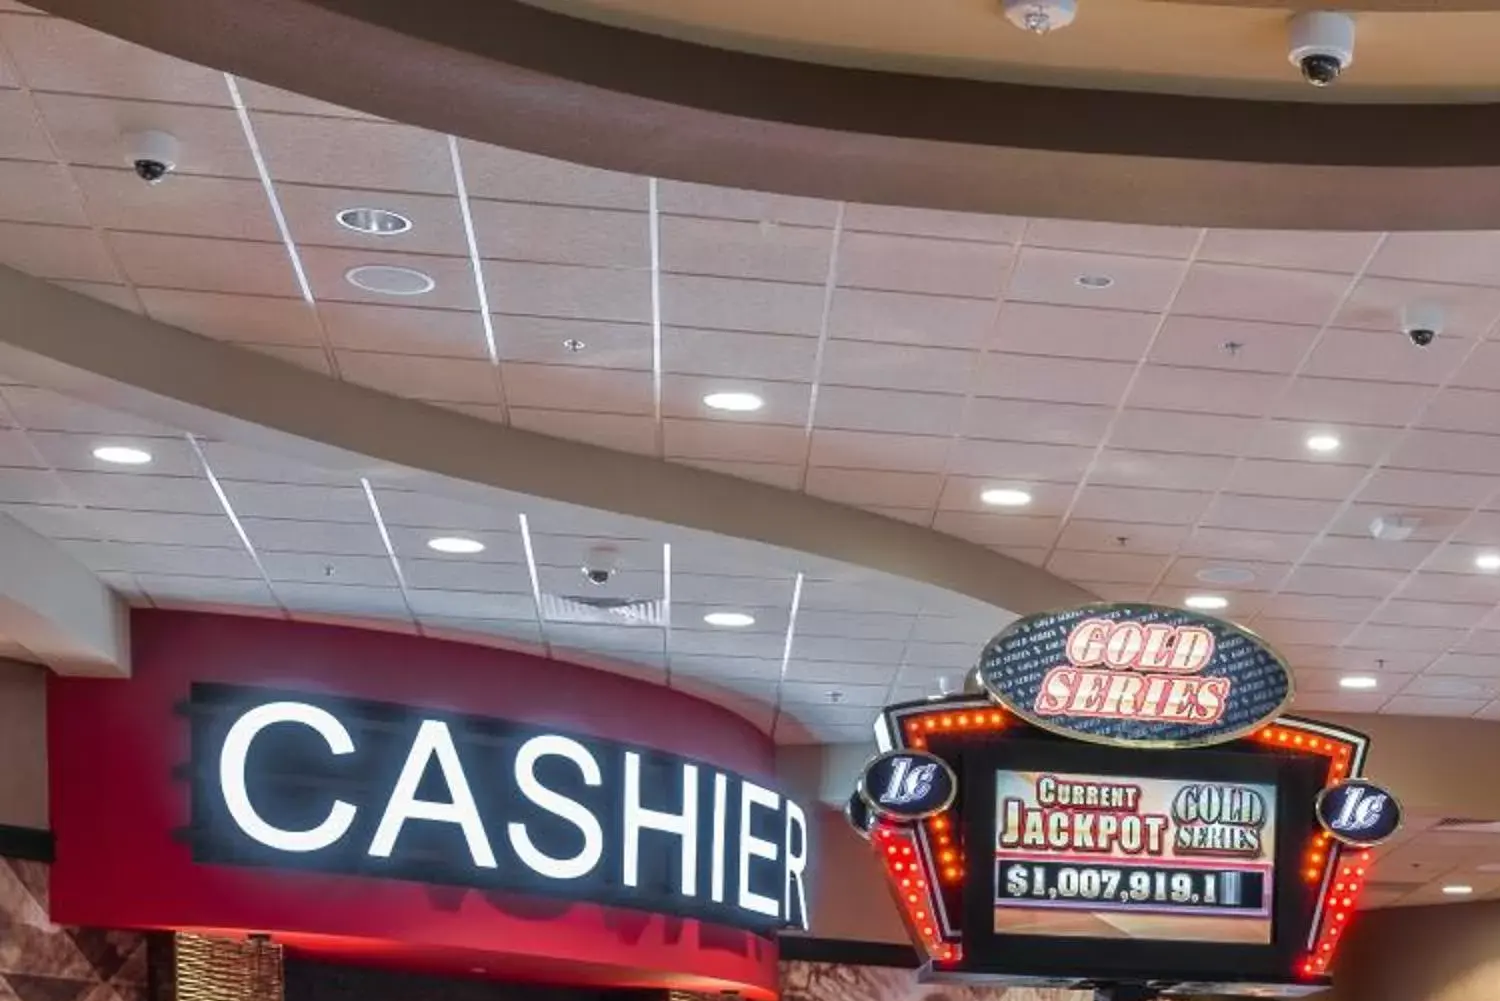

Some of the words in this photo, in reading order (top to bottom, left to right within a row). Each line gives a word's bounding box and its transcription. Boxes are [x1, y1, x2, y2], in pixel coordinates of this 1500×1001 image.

[1065, 619, 1216, 674] GOLD
[1034, 667, 1230, 723] SERIES
[220, 701, 808, 931] CASHIER
[1037, 776, 1141, 810] CURRENT
[1173, 784, 1266, 828] GOLD
[1001, 798, 1167, 853] JACKPOT
[1174, 824, 1262, 856] SERIES
